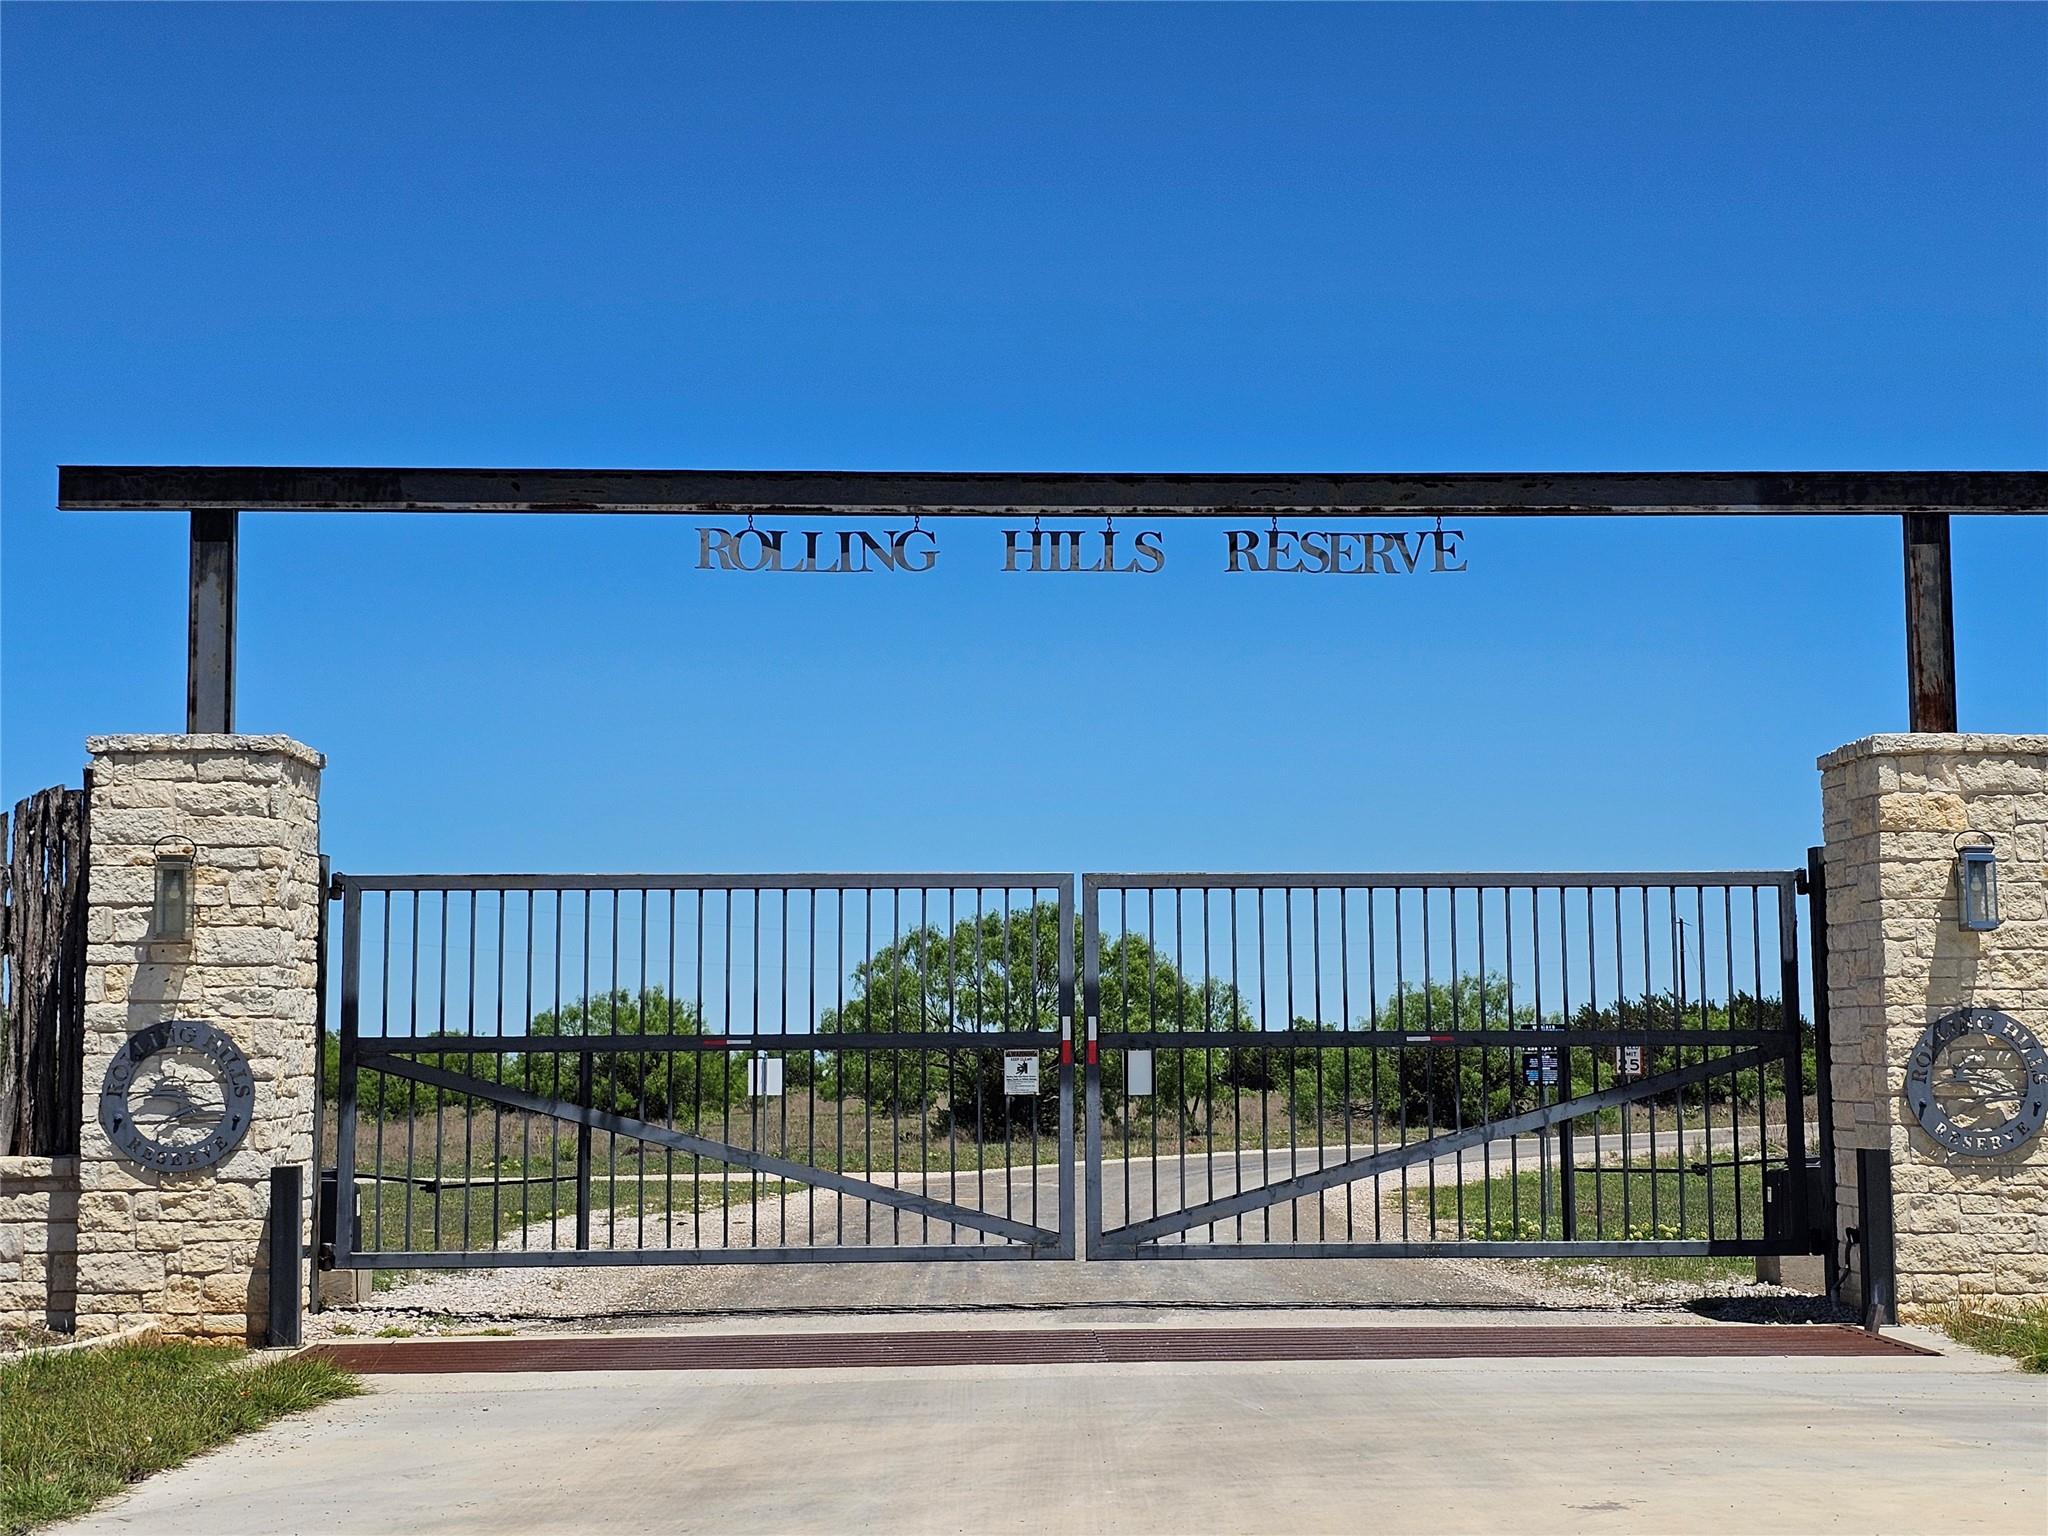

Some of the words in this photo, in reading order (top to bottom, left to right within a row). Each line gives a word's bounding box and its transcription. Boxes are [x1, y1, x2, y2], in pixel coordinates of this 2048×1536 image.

[695, 527, 940, 573] ROLLING
[1001, 530, 1165, 573] HILLS
[1223, 530, 1468, 574] RESERVE
[203, 1033, 250, 1098] HILLS
[127, 1136, 228, 1166] RESERVE
[1934, 1121, 2031, 1151] RESERVE
